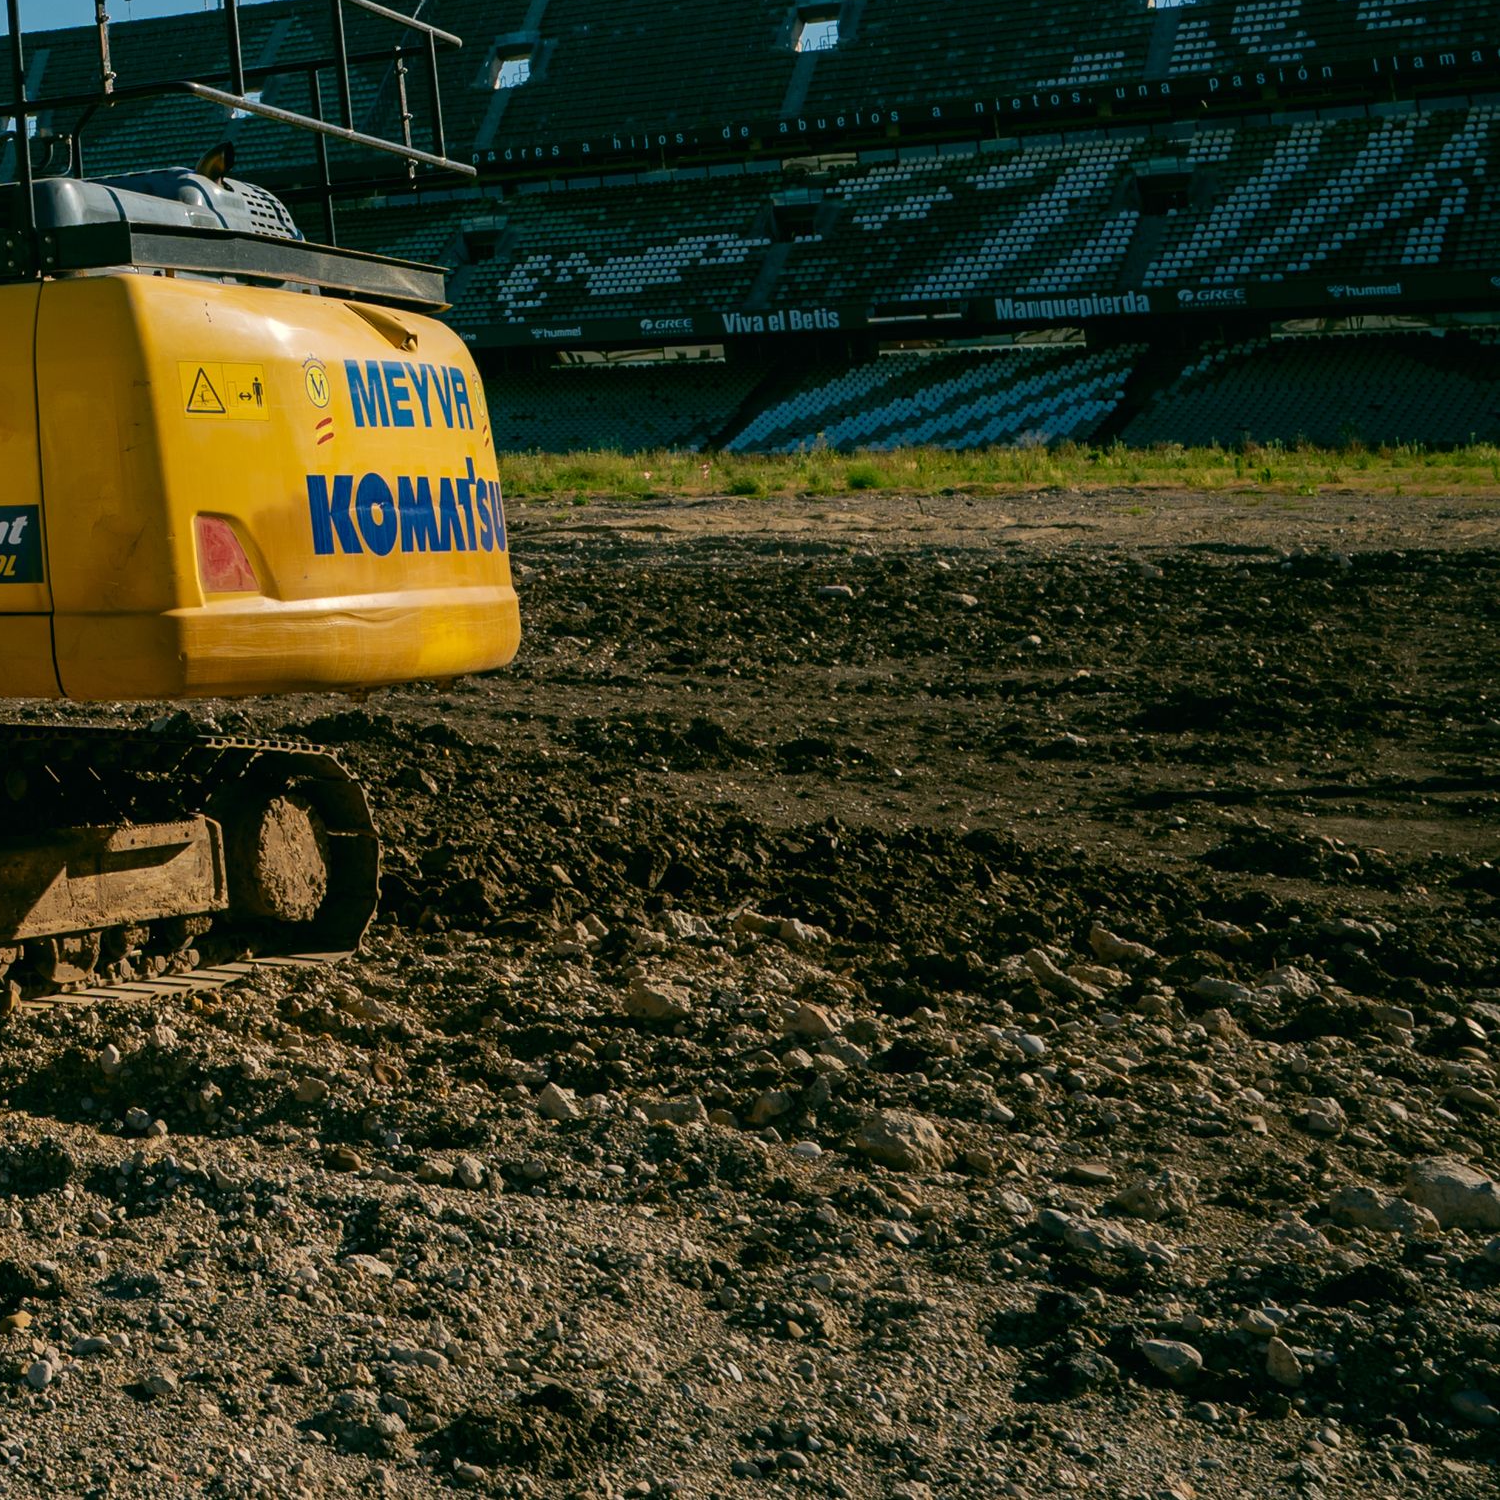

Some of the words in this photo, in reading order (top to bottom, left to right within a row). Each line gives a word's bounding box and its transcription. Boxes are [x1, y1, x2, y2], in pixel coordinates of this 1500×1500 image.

[471, 144, 560, 165] padres
[582, 141, 591, 154] a
[721, 125, 751, 140] de
[779, 109, 900, 134] abuelos
[932, 104, 942, 118] a
[1115, 81, 1171, 100] una
[1208, 64, 1334, 93] pasión
[1371, 47, 1500, 74] llama
[1196, 288, 1246, 301] GREE
[1346, 282, 1402, 297] hummel
[994, 290, 1151, 321] Manquepierda
[543, 326, 582, 339] hummel
[655, 318, 693, 329] GREE
[722, 312, 764, 334] Viva
[769, 310, 785, 332] el
[790, 308, 840, 331] Betis
[343, 359, 474, 431] MEYVA
[305, 456, 507, 557] KOMATSU
